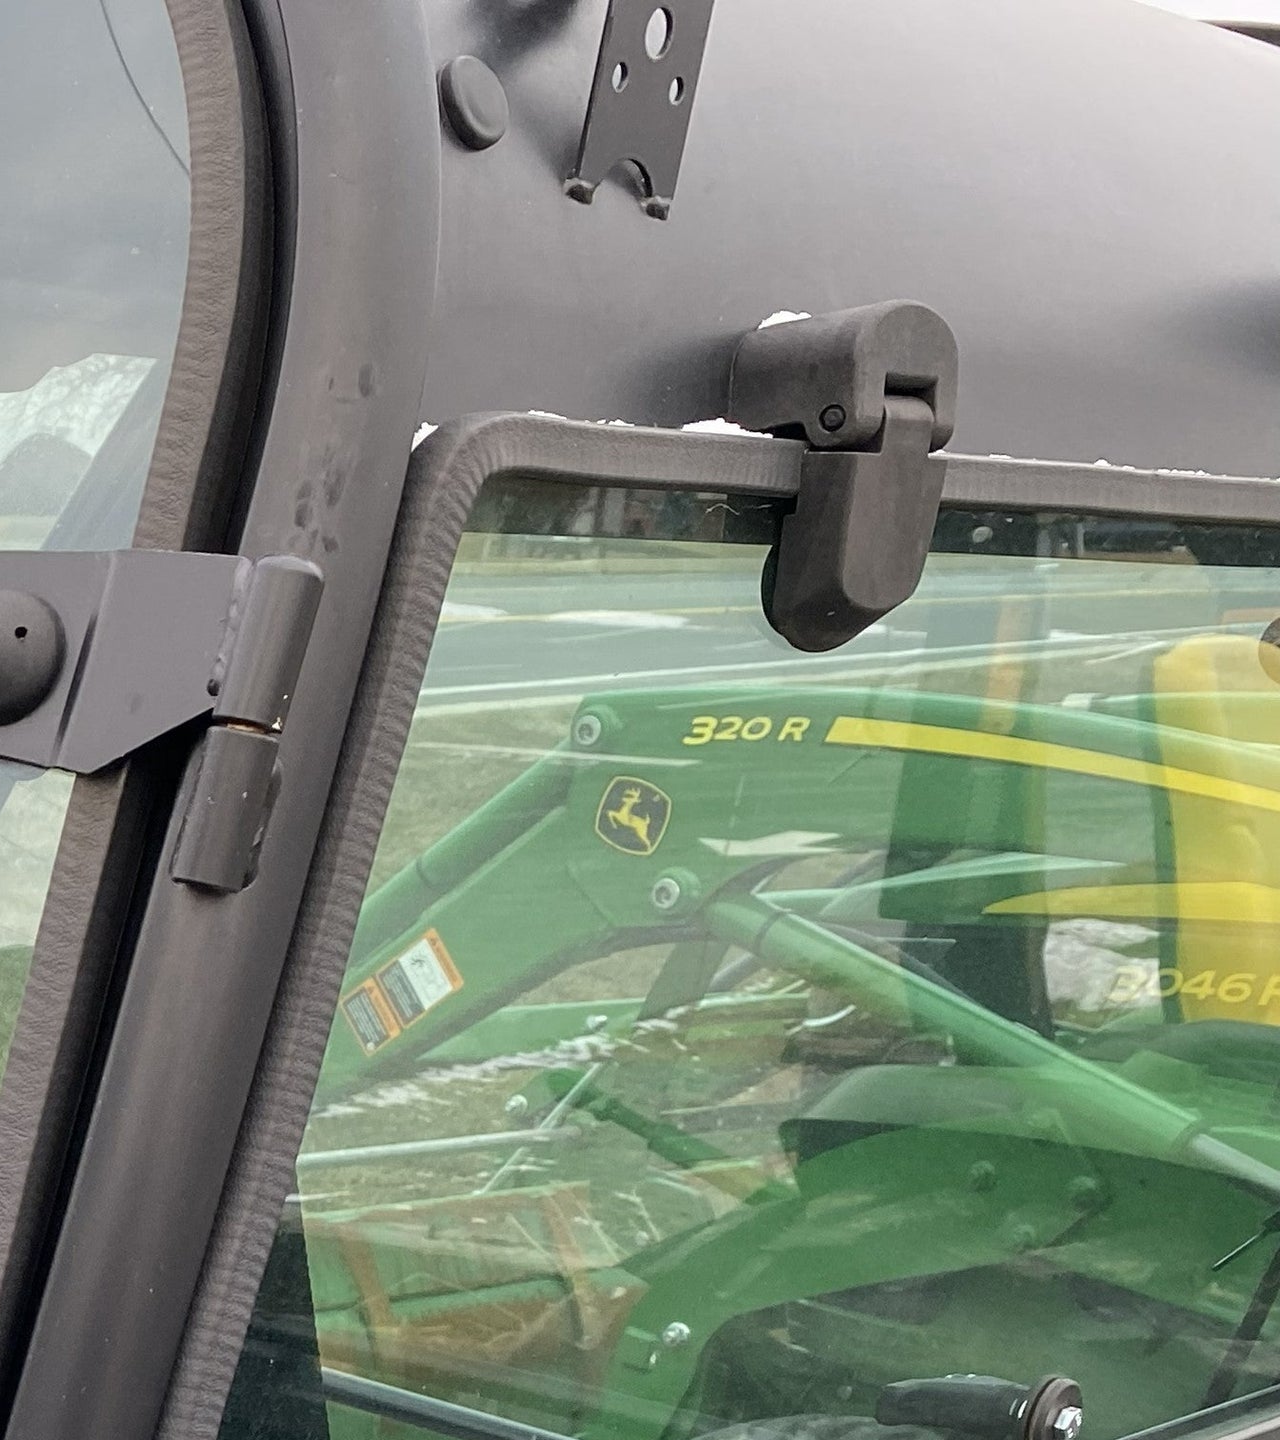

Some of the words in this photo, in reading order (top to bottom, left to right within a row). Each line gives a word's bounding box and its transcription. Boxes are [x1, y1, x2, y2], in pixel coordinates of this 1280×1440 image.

[682, 716, 773, 745] 320
[777, 716, 811, 742] R
[1108, 965, 1257, 1003] 3046
